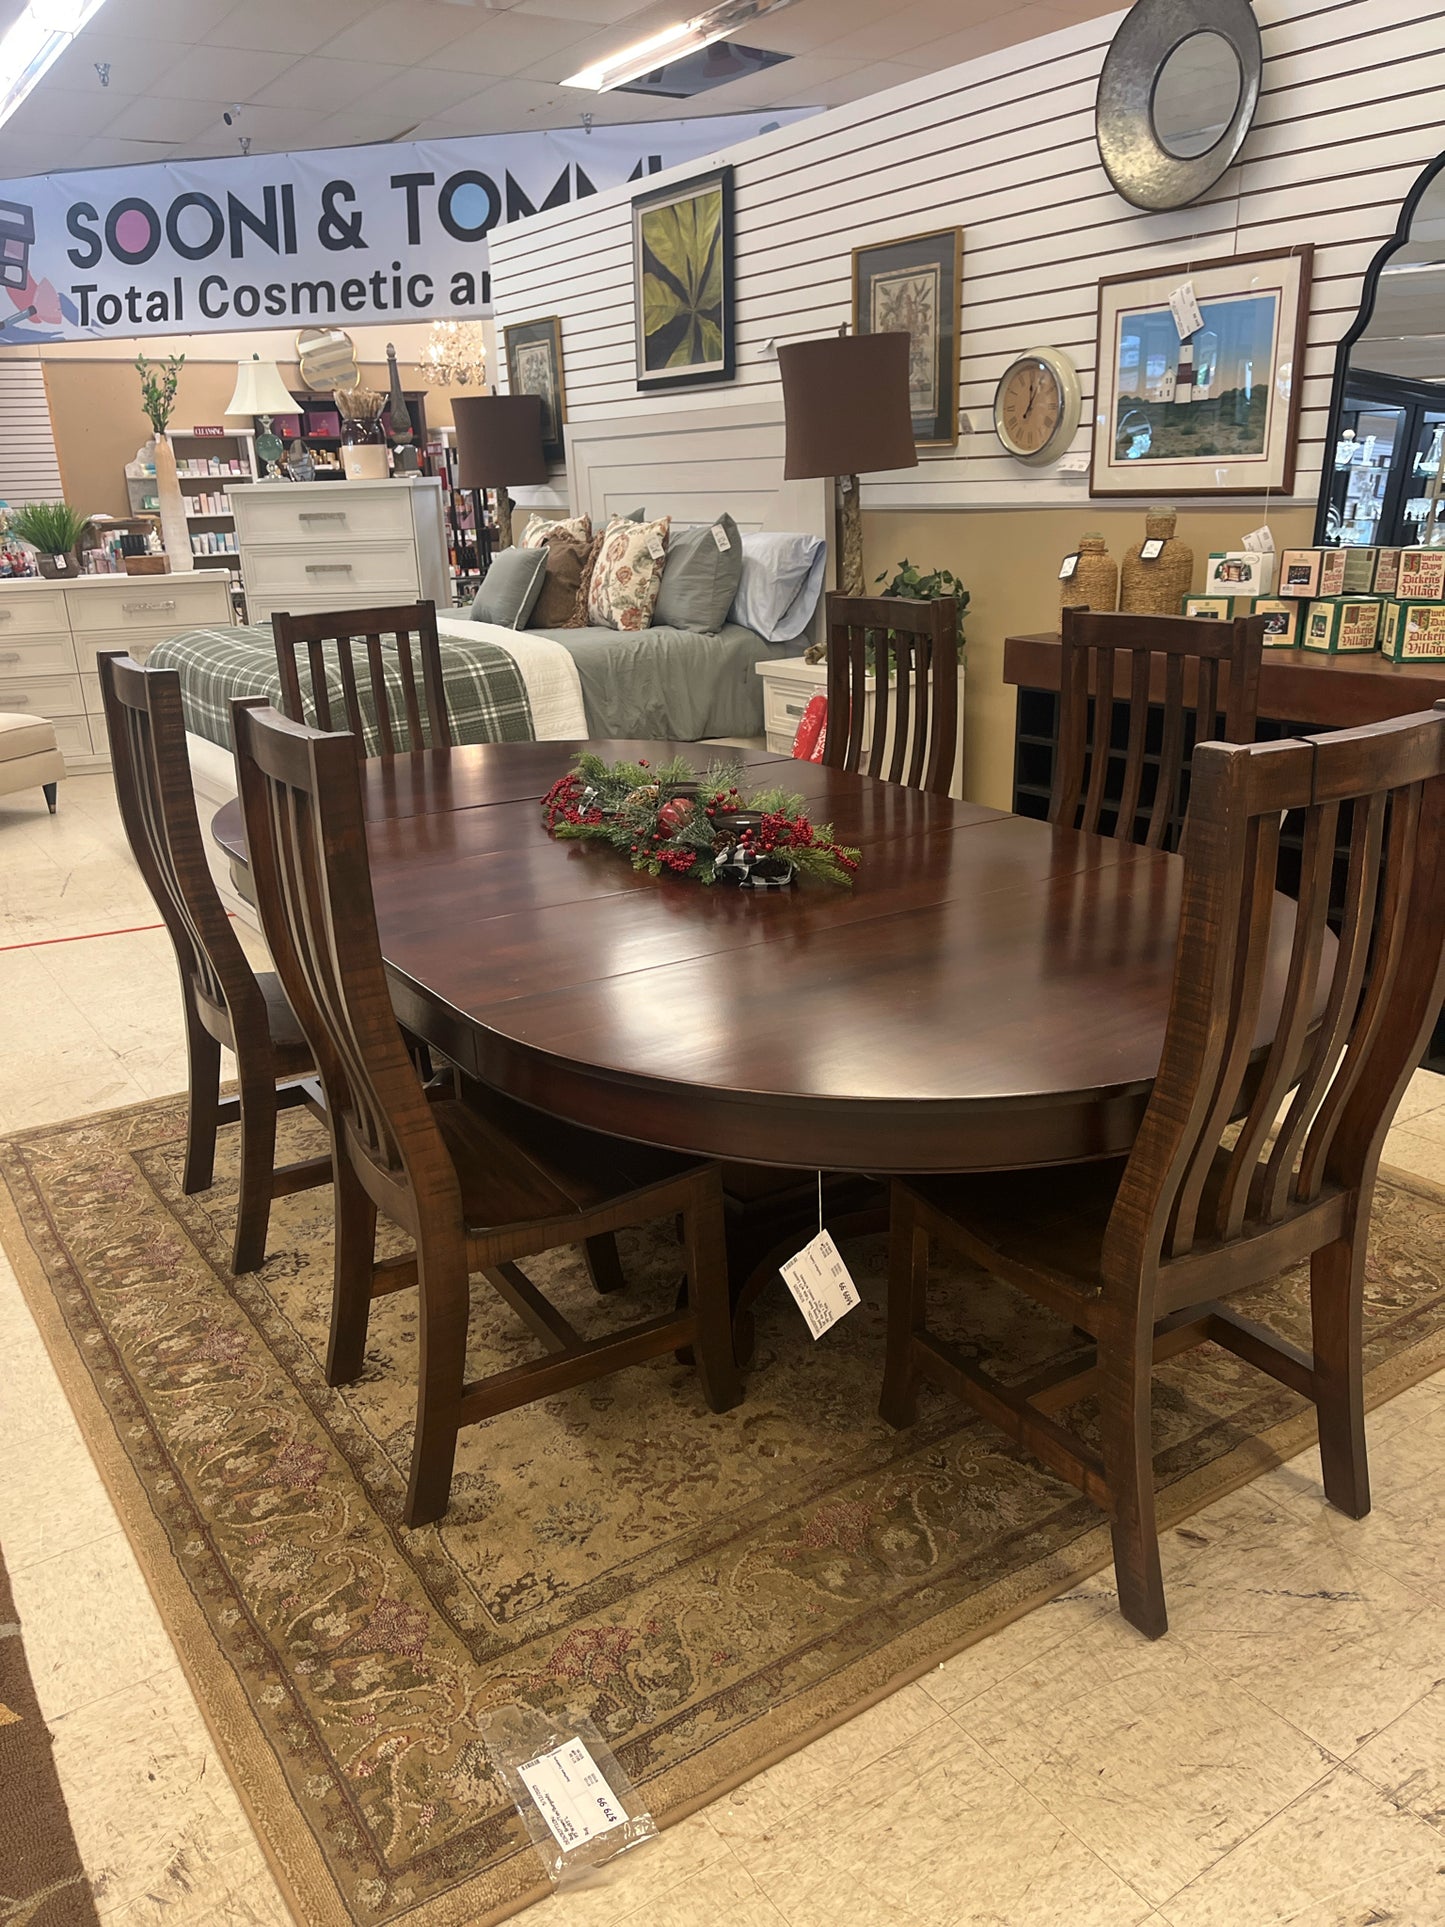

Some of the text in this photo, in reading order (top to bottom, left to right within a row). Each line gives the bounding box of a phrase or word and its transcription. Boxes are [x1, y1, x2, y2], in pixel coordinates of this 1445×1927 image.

[66, 183, 298, 269] SOONI
[318, 180, 369, 251] &
[71, 276, 183, 327] Total
[198, 262, 435, 320] Cosmetic
[1421, 562, 1442, 570] Days
[1403, 574, 1441, 584] Dickens
[1401, 585, 1440, 597] Village
[1344, 625, 1374, 635] Dickens
[1342, 635, 1372, 646] Village
[1408, 642, 1445, 655] Villag
